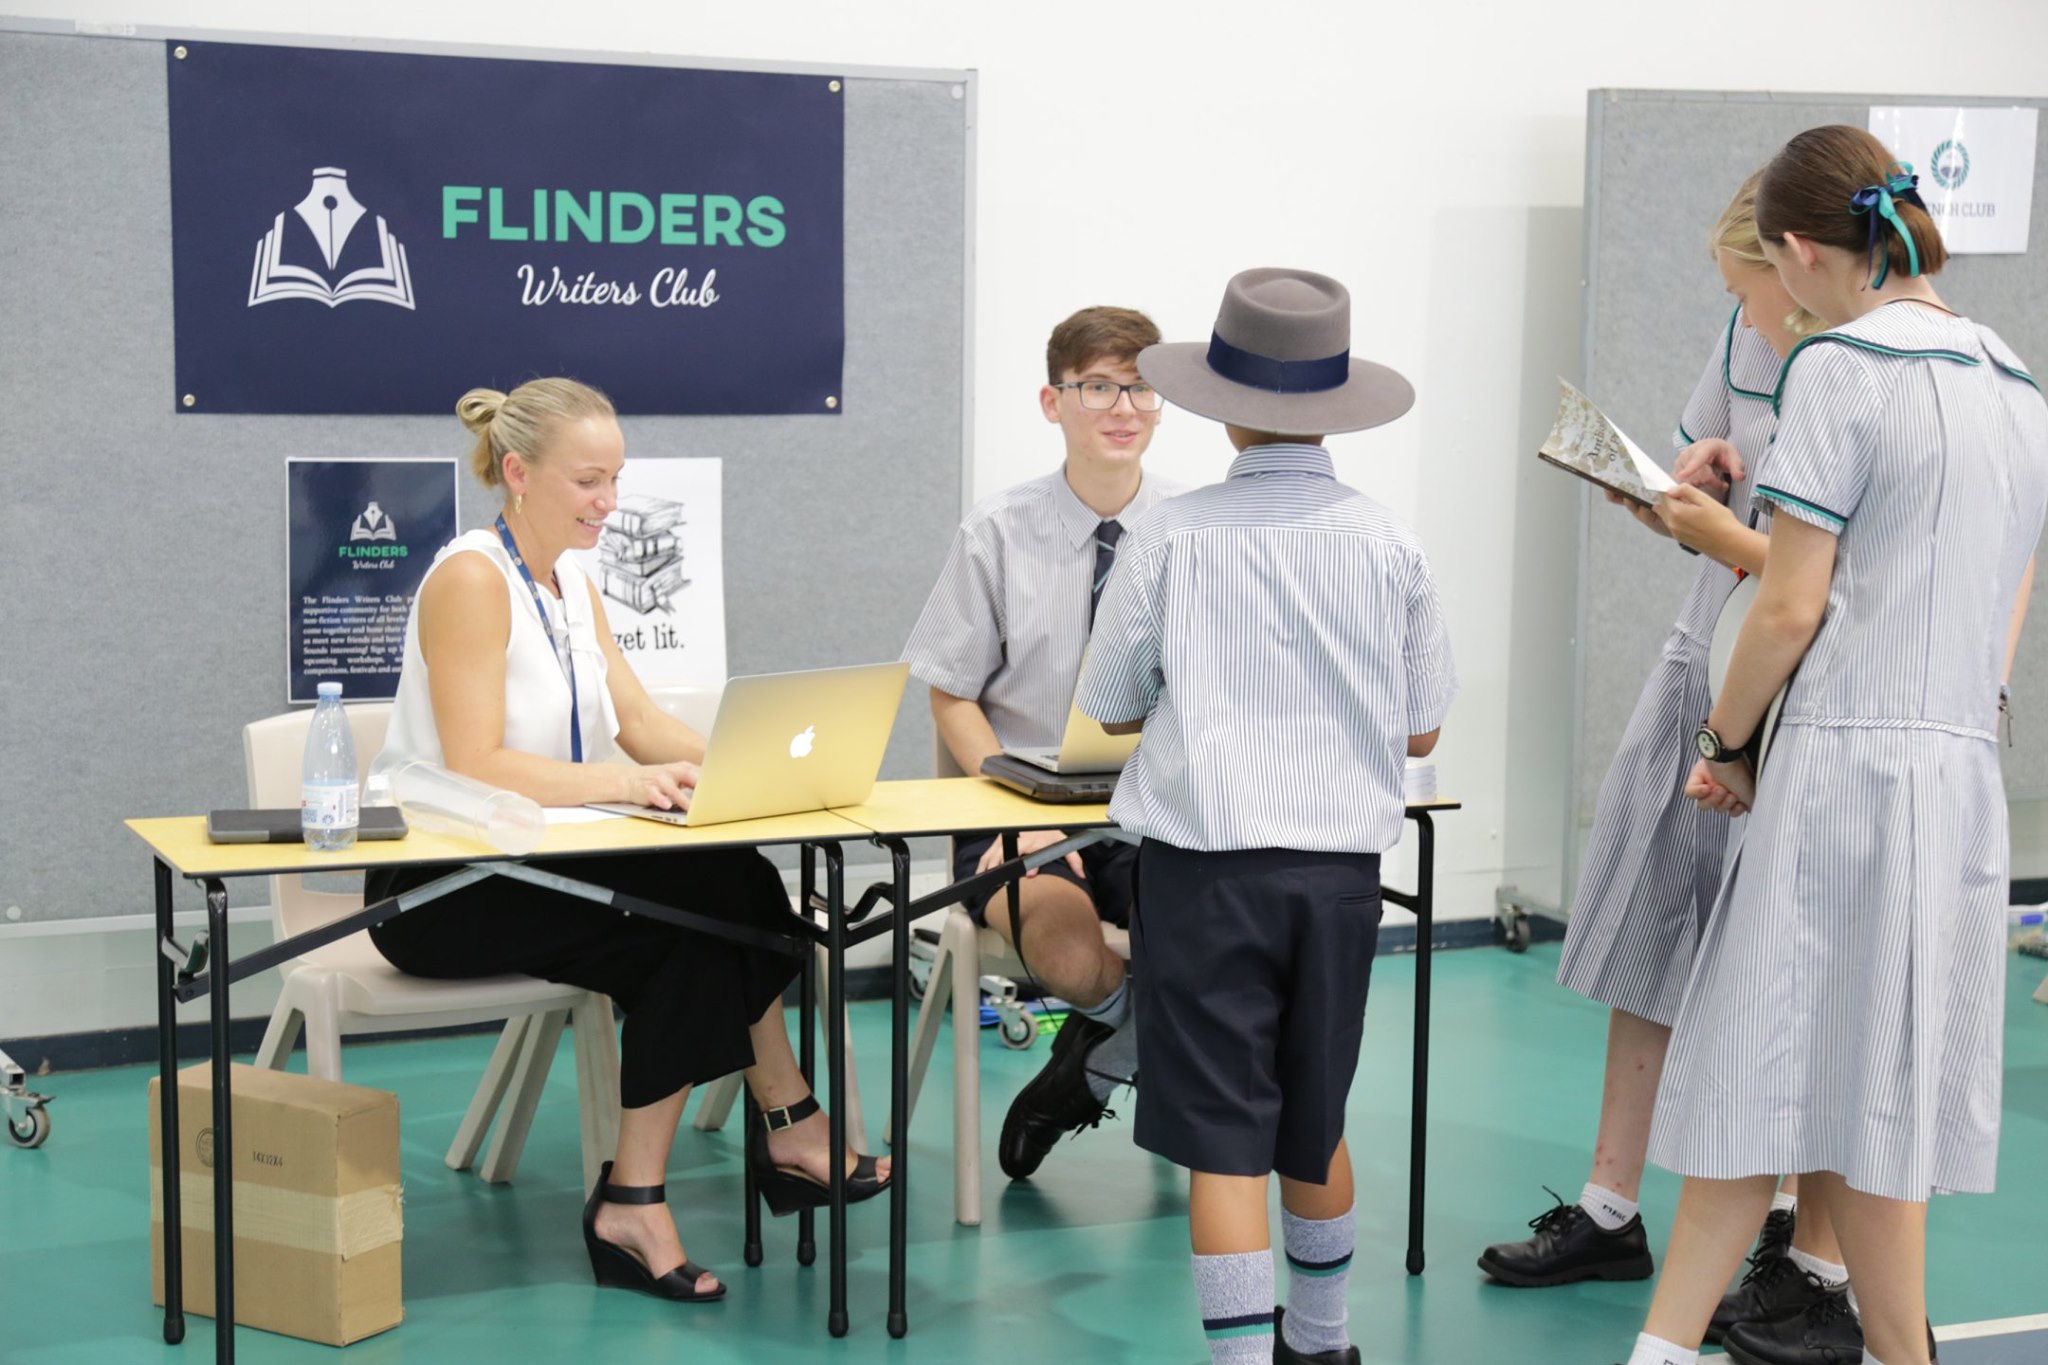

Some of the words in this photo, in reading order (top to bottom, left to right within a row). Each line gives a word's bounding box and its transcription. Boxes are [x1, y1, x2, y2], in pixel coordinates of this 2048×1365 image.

[1961, 202, 1996, 218] CLUB
[442, 185, 786, 248] FLINDERS
[517, 263, 642, 306] Writers
[649, 267, 720, 308] Club
[338, 545, 409, 558] FLINDERS
[352, 560, 379, 570] Writers
[379, 560, 396, 570] Club
[303, 596, 318, 604] The
[322, 596, 350, 604] Flinders
[354, 595, 381, 603] Writers
[385, 595, 403, 603] Club
[302, 607, 338, 616] supportive
[339, 607, 377, 615] community
[323, 625, 351, 636] together
[352, 626, 365, 634] and
[653, 622, 685, 650] lit.
[346, 635, 370, 644] friends
[371, 635, 385, 643] and
[385, 635, 403, 643] have
[303, 646, 328, 655] Sounds
[330, 645, 368, 656] interesting!
[303, 658, 338, 667] upcoming
[350, 664, 377, 674] festivals
[378, 664, 391, 674] and
